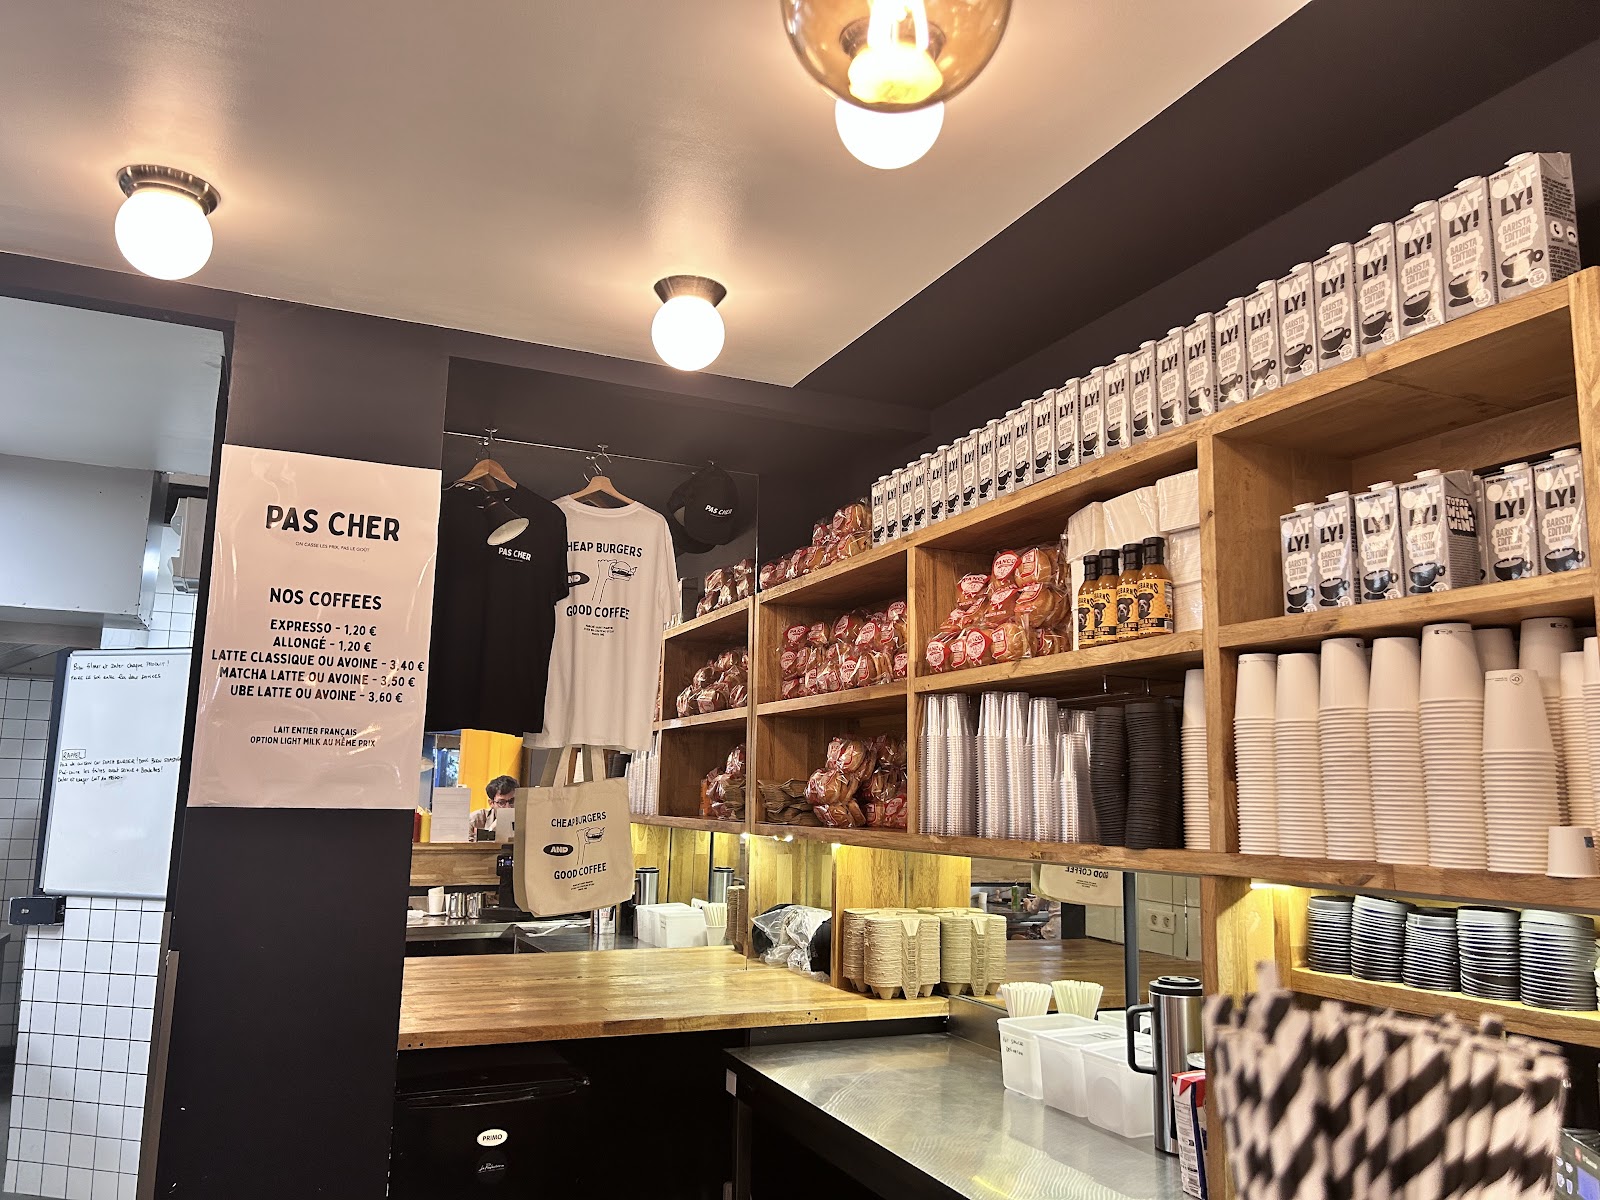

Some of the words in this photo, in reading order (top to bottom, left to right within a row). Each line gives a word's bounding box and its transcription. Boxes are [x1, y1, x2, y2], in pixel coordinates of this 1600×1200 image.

[1501, 186, 1532, 216] LY!
[1449, 209, 1478, 238] LY!
[1503, 215, 1532, 235] BARISTA
[1505, 225, 1531, 243] EDITION
[1405, 232, 1432, 260] LY!
[1451, 237, 1477, 256] BARISTA
[1452, 247, 1476, 264] EDITION
[1363, 255, 1387, 281] LY!
[1405, 259, 1430, 276] BARISTA
[1407, 268, 1429, 284] EDITION
[1321, 273, 1344, 298] LY!
[1363, 281, 1385, 297] BARISTA
[1284, 291, 1306, 315] LY!
[1364, 289, 1385, 304] EDITION
[1251, 309, 1270, 331] LY!
[1220, 325, 1238, 346] LY!
[1189, 340, 1205, 360] LY!
[1162, 353, 1177, 373] LY!
[1135, 367, 1149, 386] LY!
[1109, 379, 1124, 396] LY!
[1085, 391, 1099, 408] LY!
[1060, 401, 1073, 418] LY!
[1037, 412, 1050, 428] LY!
[1017, 422, 1028, 437] LY!
[982, 441, 991, 455] LY!
[1000, 432, 1010, 447] LY!
[965, 450, 974, 464] LY!
[1446, 496, 1468, 506] TOTAL
[1545, 486, 1576, 509] LY!
[705, 504, 718, 514] PAS
[1495, 498, 1524, 520] LY!
[265, 504, 318, 533] PAS
[328, 512, 400, 542] CHER
[1363, 514, 1391, 535] LY!
[1547, 515, 1573, 528] BARISTA
[1320, 524, 1344, 544] LY!
[1548, 527, 1572, 537] EDITION
[567, 542, 593, 552] HEAP
[596, 543, 642, 558] BURGERS
[1288, 534, 1309, 553] LY!
[498, 547, 512, 556] PAS
[514, 550, 532, 561] CHER
[1289, 558, 1308, 566] BARISTA
[1321, 549, 1342, 559] BARISTA
[568, 574, 581, 584] ND
[270, 587, 304, 604] NOS
[310, 591, 382, 610] COFFEES
[566, 604, 592, 616] GOOD
[270, 619, 332, 634] EXPRESSO
[344, 624, 366, 636] 1,20
[369, 626, 377, 636] €
[273, 636, 326, 649] ALLONGÉ
[339, 641, 360, 652] 1,20
[364, 642, 371, 652] €
[212, 649, 247, 661] LATTE
[250, 652, 315, 665] CLASSIQUE
[318, 656, 334, 666] OU
[337, 657, 378, 669] AVOINE
[390, 660, 414, 671] 3,40
[418, 662, 424, 671] €
[220, 667, 267, 680] MATCHA
[271, 670, 305, 682] LATTE
[308, 672, 324, 683] OU
[328, 673, 368, 685] AVOINE
[380, 676, 404, 687] 3,50
[408, 677, 416, 687] €
[230, 685, 254, 696] UBE
[258, 686, 292, 698] LATTE
[296, 688, 312, 699] OU
[314, 689, 356, 701] AVOINE
[368, 692, 392, 703] 3,60
[396, 692, 403, 702] €
[292, 726, 318, 734] ENTIER
[320, 728, 357, 737] FRANÇAIS
[250, 736, 278, 744] OPTION
[280, 737, 301, 745] LIGHT
[303, 737, 320, 746] MILK
[335, 736, 356, 746] MÊME
[551, 818, 575, 828] CHEAP
[576, 811, 606, 825] BURGERS
[554, 869, 578, 880] GOOD
[579, 862, 607, 876] COFFEE
